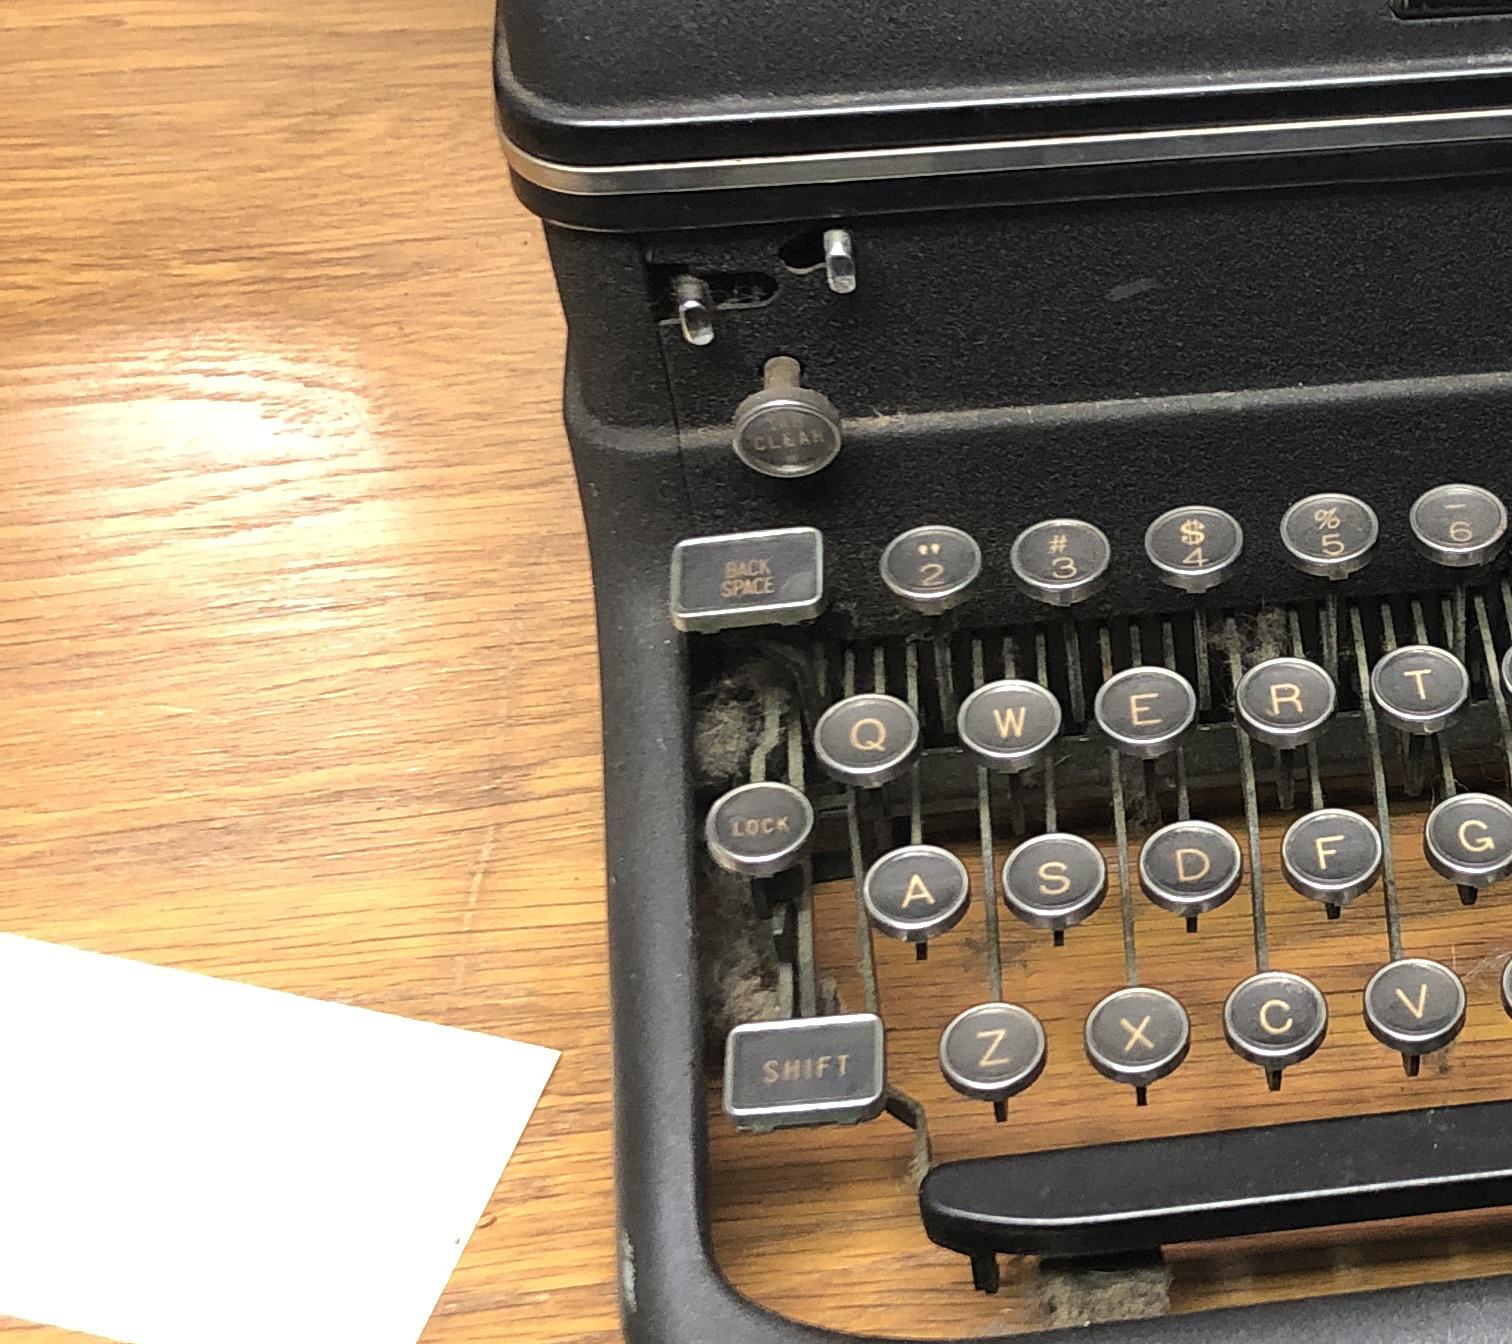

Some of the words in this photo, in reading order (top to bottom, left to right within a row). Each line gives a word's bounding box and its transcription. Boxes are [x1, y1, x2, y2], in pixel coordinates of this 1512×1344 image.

[1180, 518, 1205, 546] $
[1313, 506, 1341, 530] %
[1446, 520, 1473, 547] 6
[1049, 534, 1068, 554] #
[1182, 546, 1209, 568] 4
[1321, 533, 1345, 557] 5
[919, 563, 944, 586] 2
[1051, 556, 1078, 579] 3
[720, 576, 775, 598] SPACE
[1270, 683, 1304, 715] R
[1404, 669, 1431, 700] T
[992, 706, 1027, 738] W
[1129, 692, 1162, 726] E
[849, 717, 887, 751] Q
[731, 815, 789, 838] LOCK
[1458, 819, 1495, 852] G
[1175, 848, 1211, 882] D
[1314, 834, 1345, 870] F
[901, 874, 936, 908] A
[1037, 861, 1071, 895] S
[1259, 999, 1293, 1035] C
[1395, 983, 1429, 1019] V
[976, 1028, 1009, 1067] Z
[1119, 1014, 1154, 1052] X
[761, 1053, 850, 1085] SHIFT
